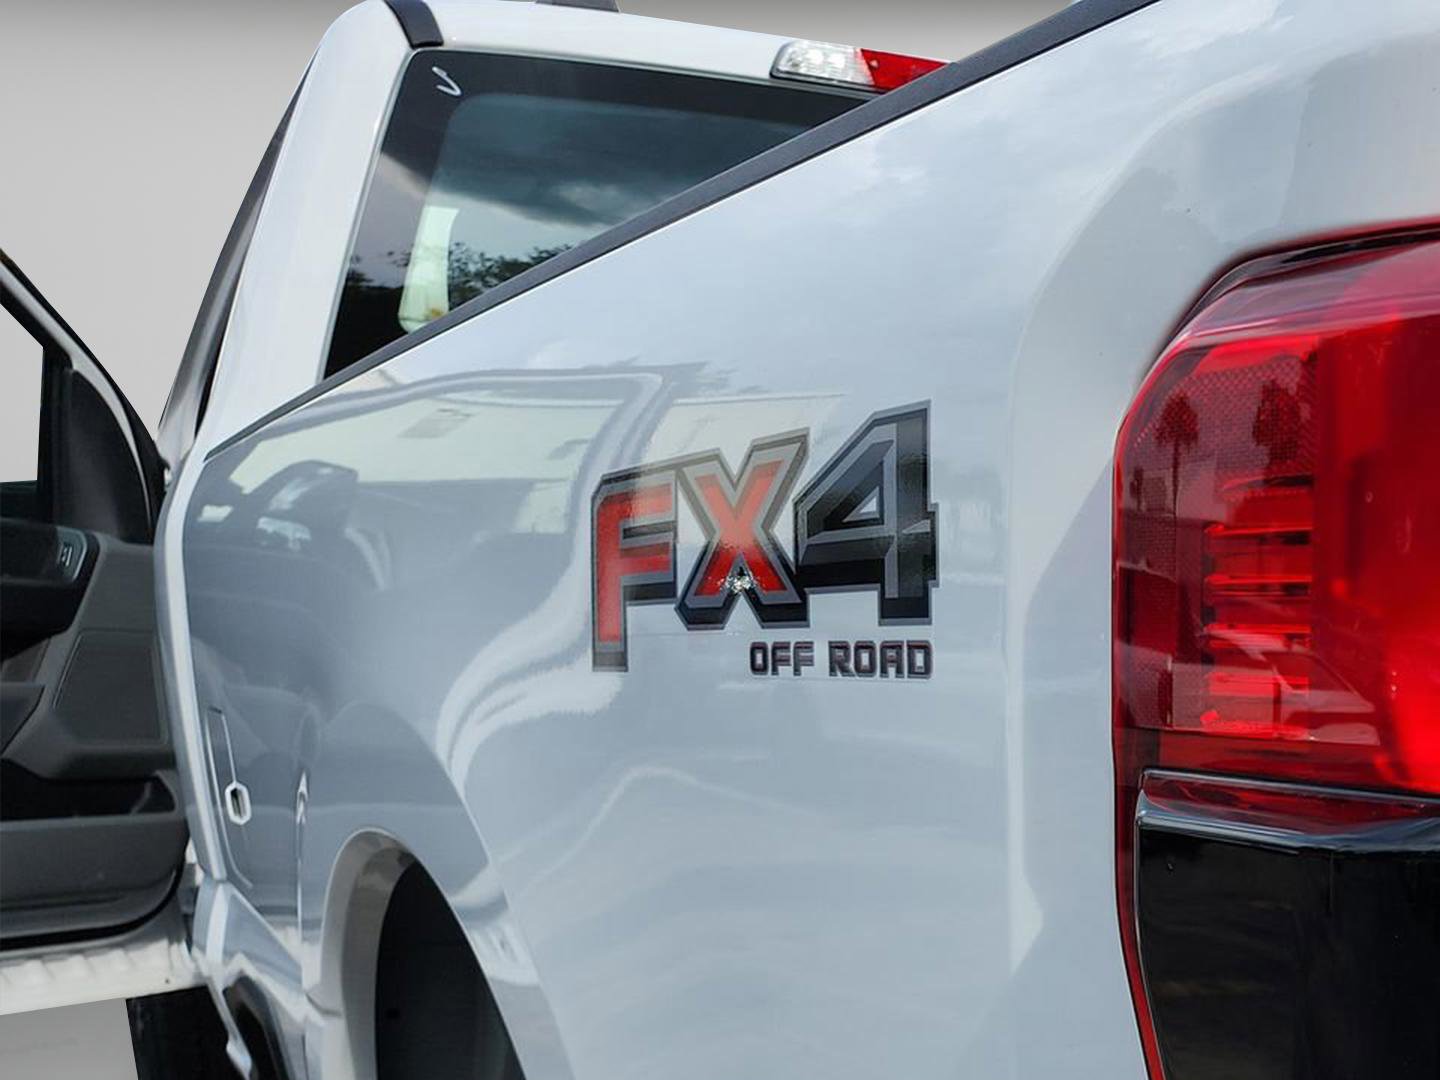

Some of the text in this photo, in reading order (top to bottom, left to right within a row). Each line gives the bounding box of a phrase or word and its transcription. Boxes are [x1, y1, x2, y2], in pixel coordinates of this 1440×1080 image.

[592, 399, 938, 672] FX4
[749, 639, 933, 680] OFF ROAD
